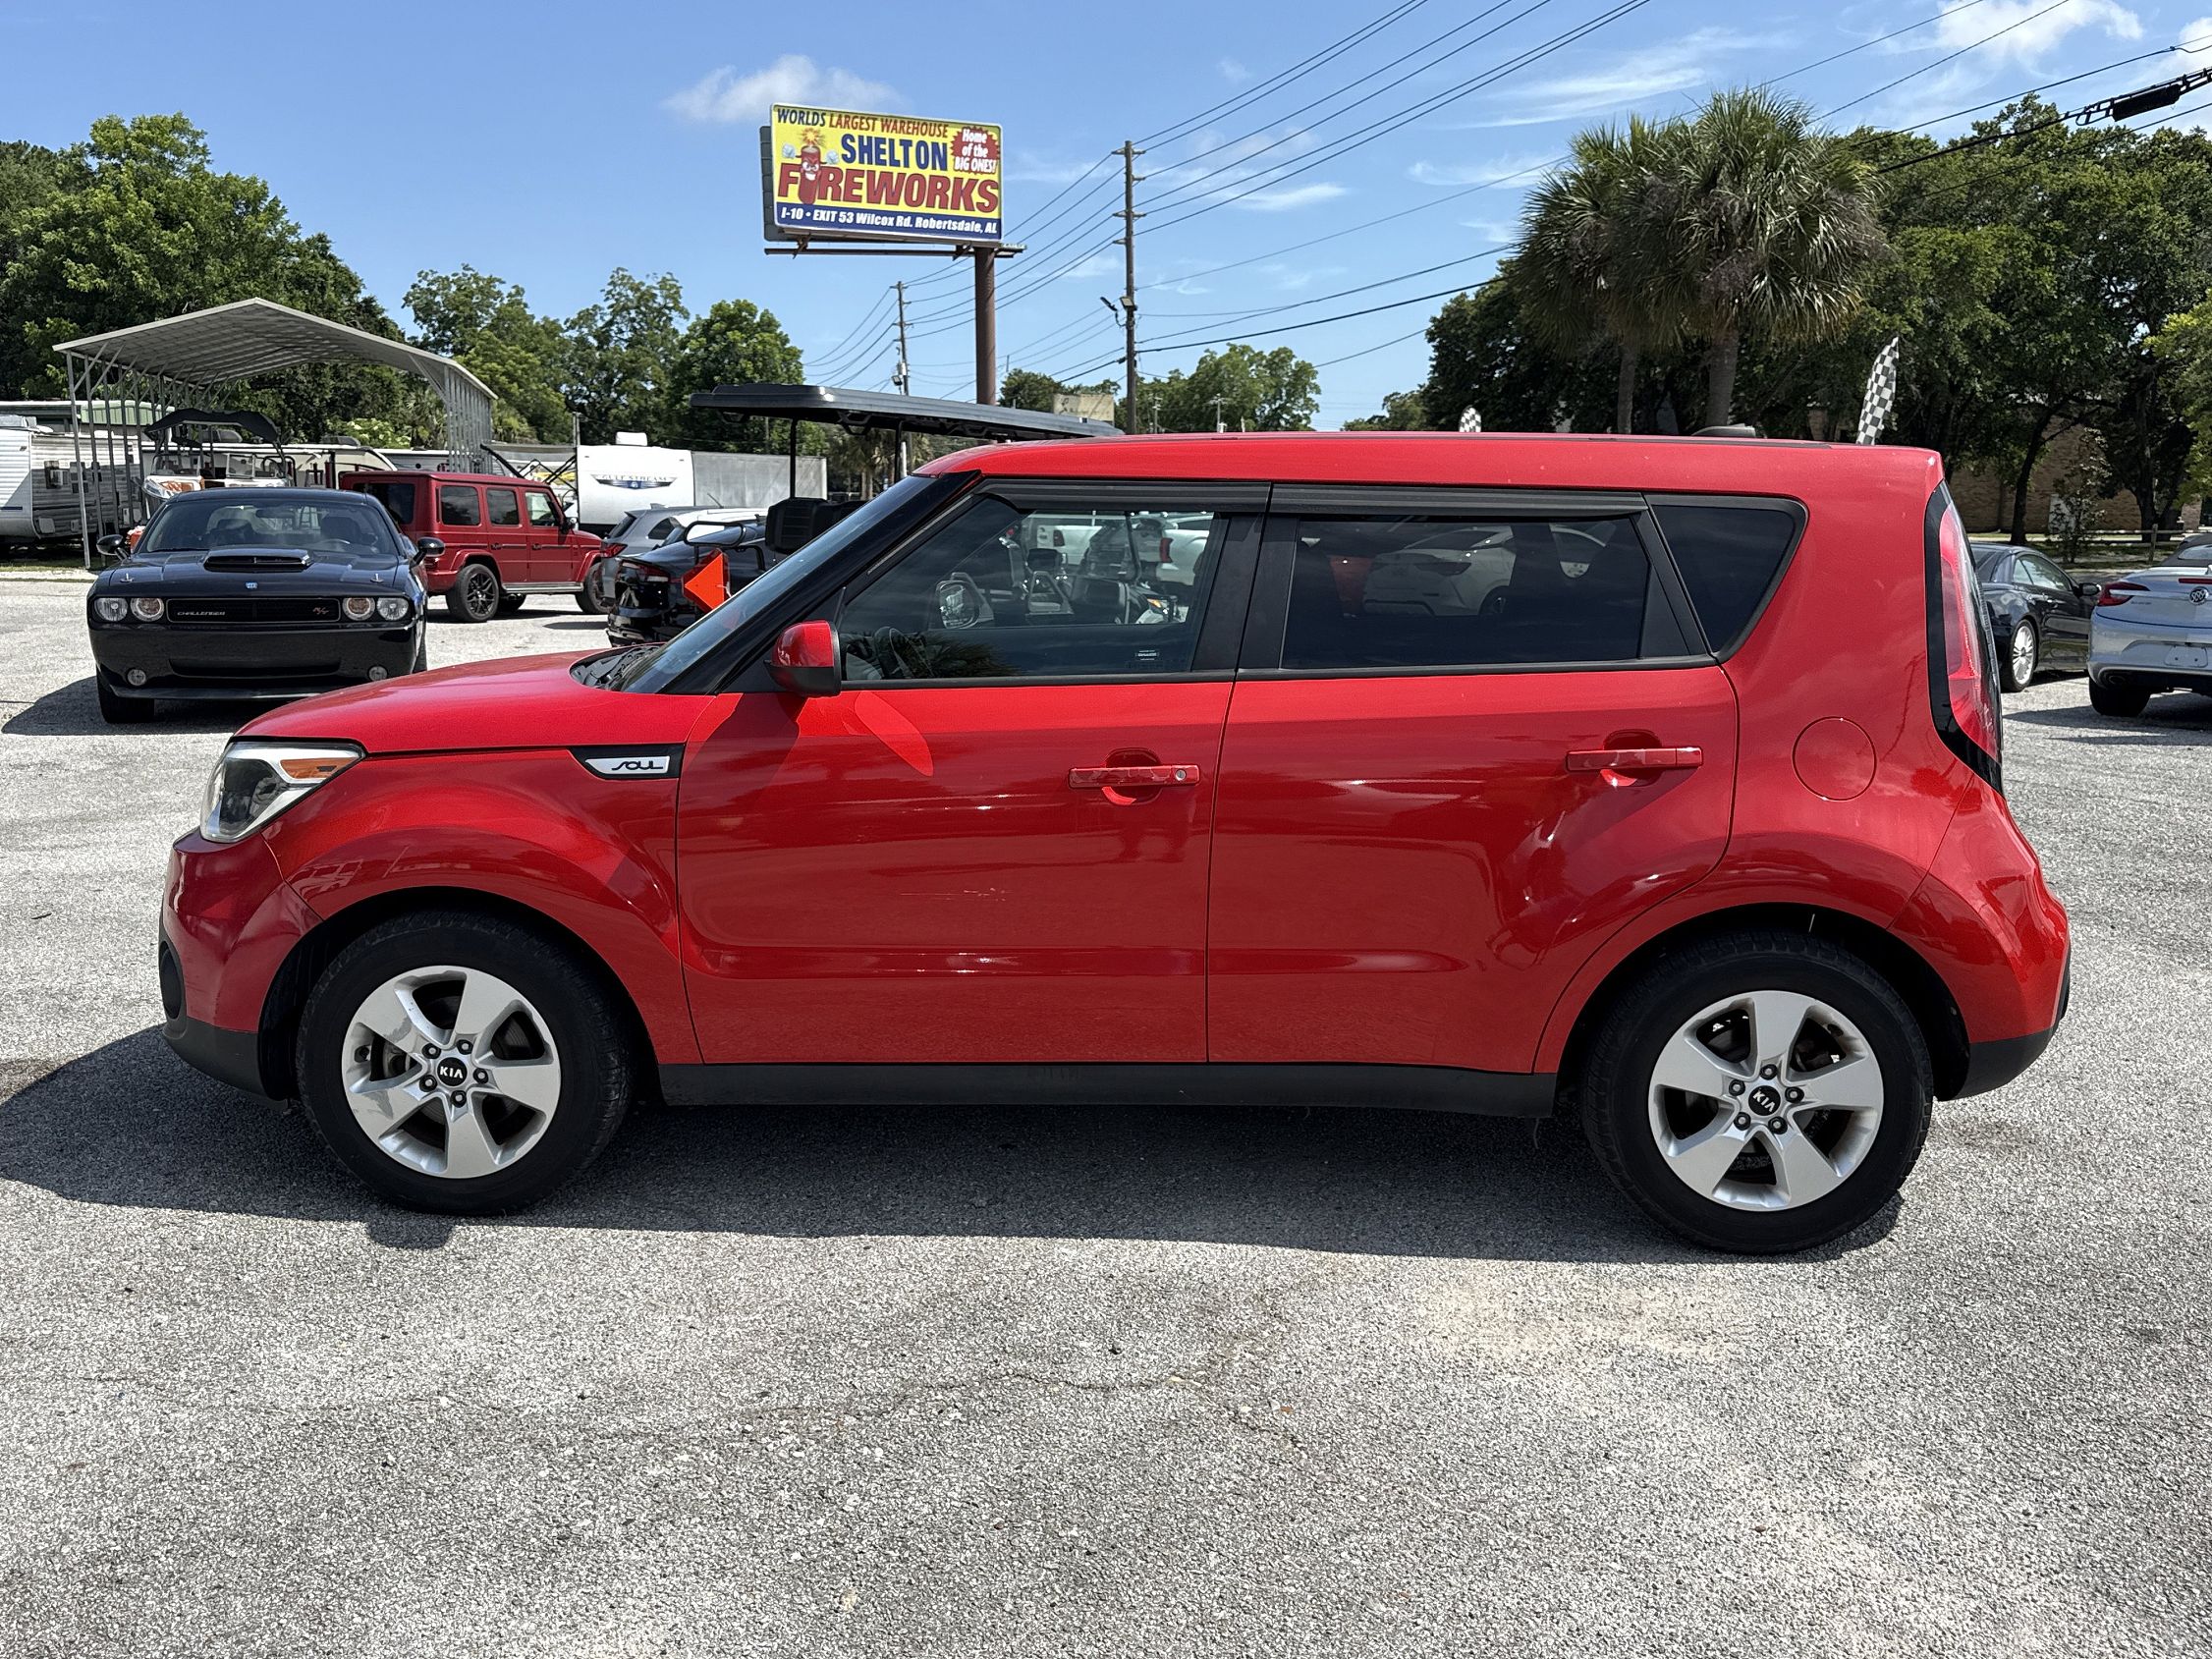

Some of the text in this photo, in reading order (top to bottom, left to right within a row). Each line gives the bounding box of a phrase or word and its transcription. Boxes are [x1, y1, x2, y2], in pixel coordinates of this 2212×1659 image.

[777, 108, 949, 138] WORLDS LARGEST WAREHOUSE
[962, 128, 988, 143] Home
[841, 134, 948, 172] SHELTON
[962, 142, 989, 158] of the
[954, 156, 998, 174] BIG ONES!
[778, 162, 999, 213] FIREWORKS
[781, 206, 998, 234] I-10 EXIT 53 Wilcox Rd. Robertsdale, AL
[611, 760, 664, 771] SOUL
[439, 1066, 464, 1078] KIA
[1752, 1090, 1776, 1112] KIA
